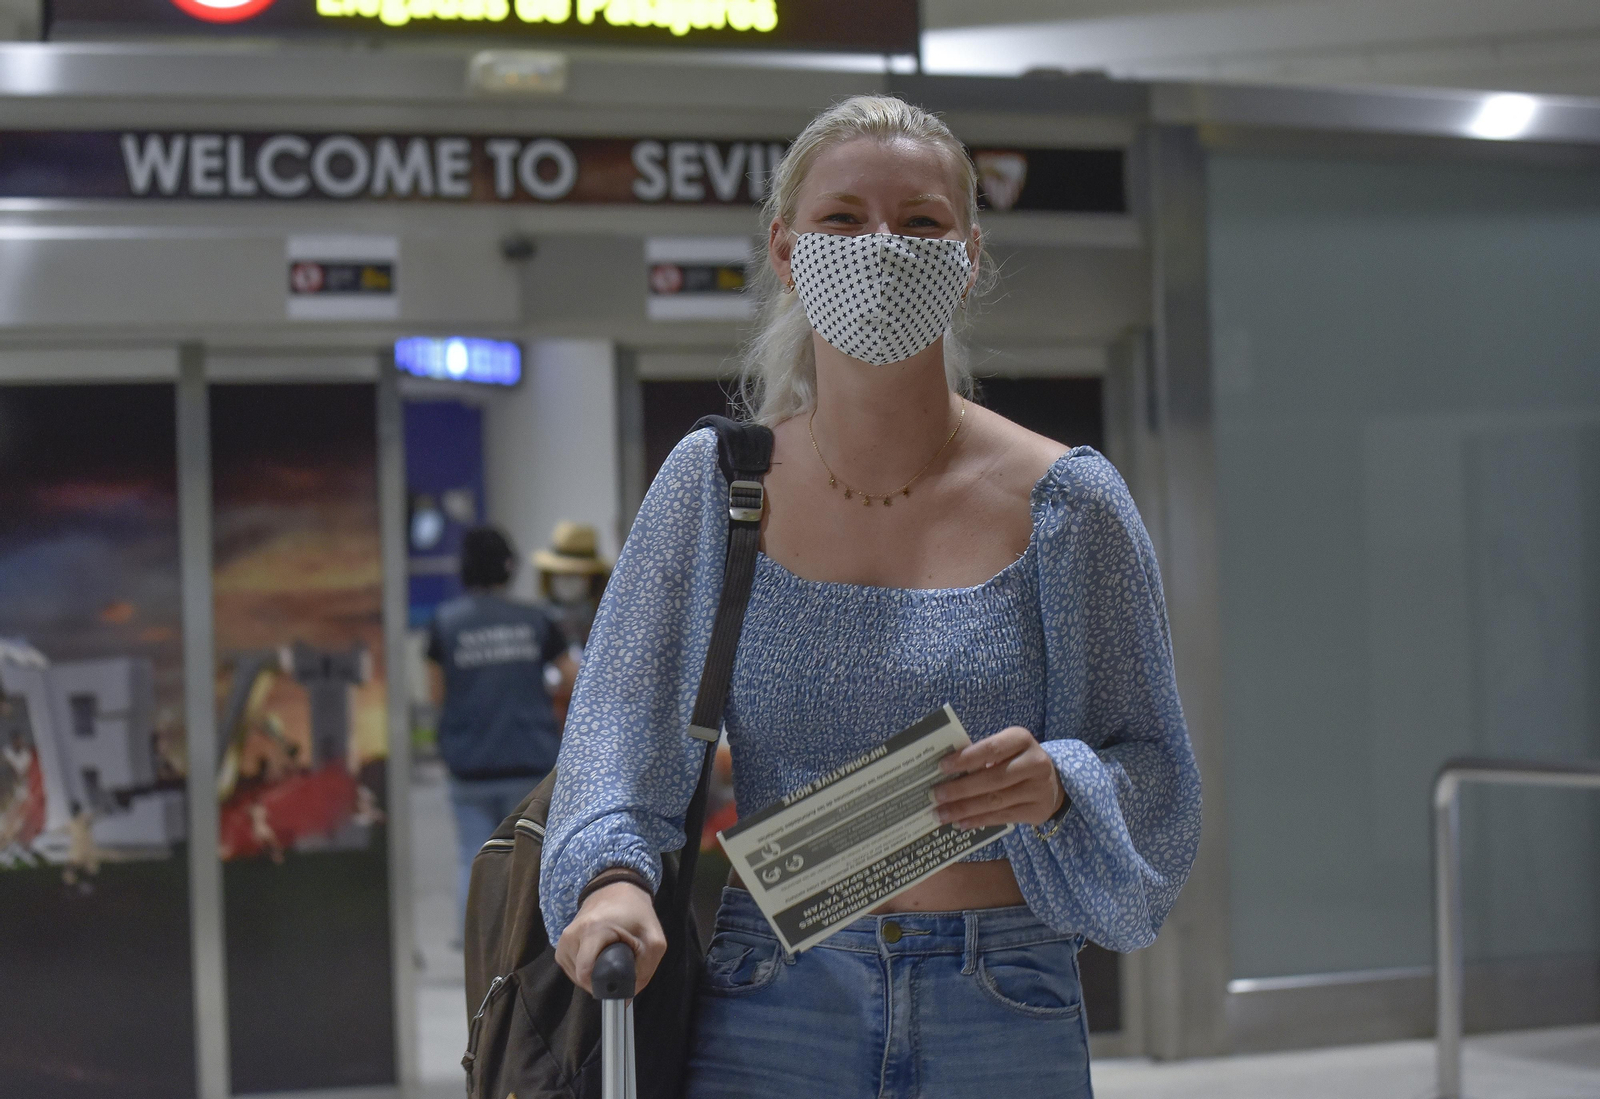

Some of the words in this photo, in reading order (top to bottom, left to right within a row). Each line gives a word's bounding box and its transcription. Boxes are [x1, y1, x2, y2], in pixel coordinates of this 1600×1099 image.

[120, 134, 471, 197] WELCOME
[485, 138, 577, 200] TO
[814, 744, 887, 788] INFORMATIVE
[782, 783, 814, 806] NOTE
[915, 829, 957, 856] VUELOS
[942, 839, 971, 859] NOTA
[865, 856, 909, 884] BUQUES
[871, 859, 887, 872] EN
[893, 840, 954, 878] PASAJEROS
[841, 881, 864, 897] QUE
[870, 856, 941, 900] INFORMATIVA
[798, 881, 882, 929] TRIPULACIONES
[803, 894, 839, 918] VAYAN
[821, 897, 869, 926] DIRIGIDA
